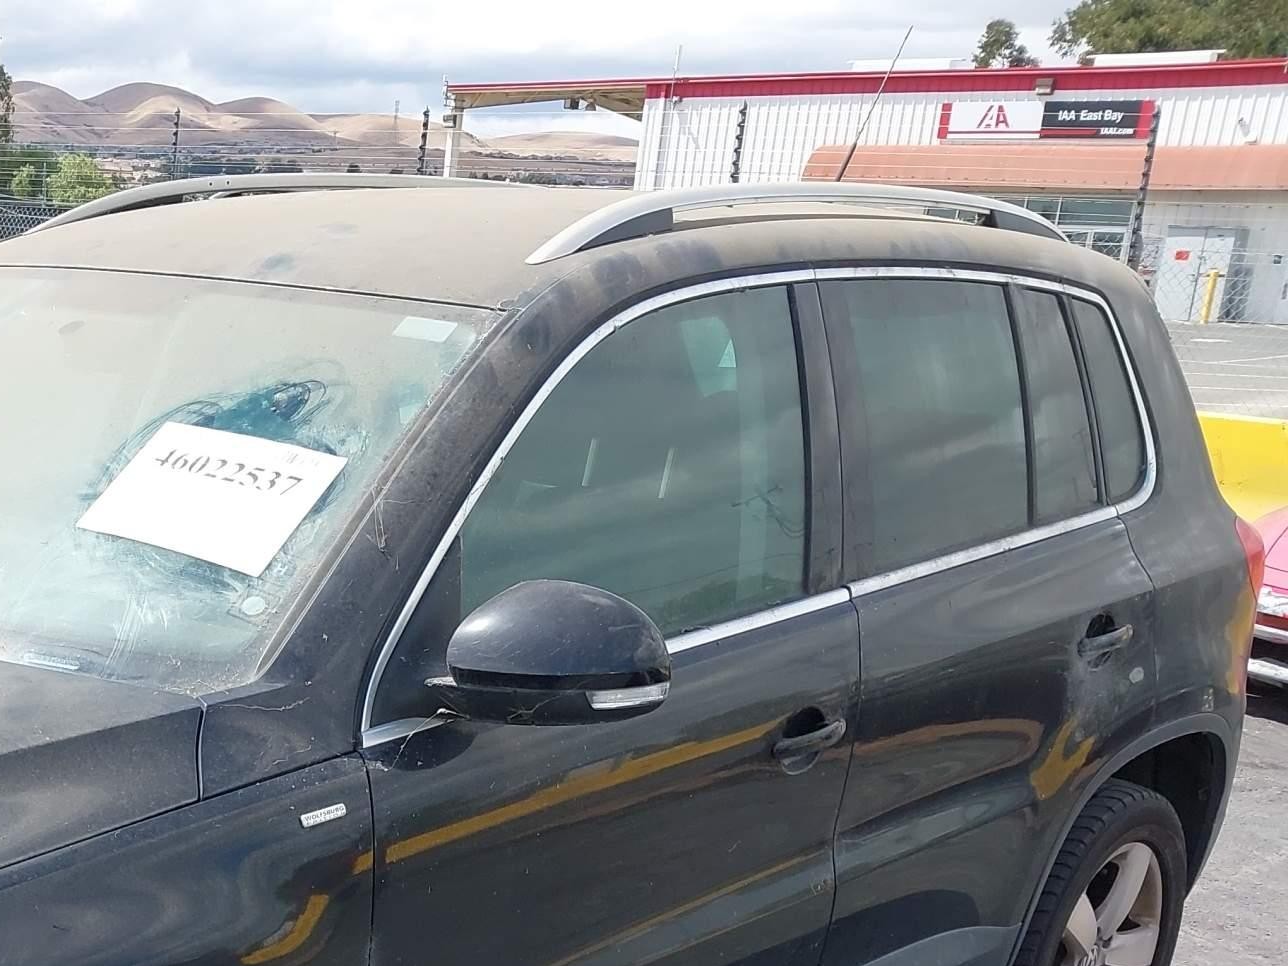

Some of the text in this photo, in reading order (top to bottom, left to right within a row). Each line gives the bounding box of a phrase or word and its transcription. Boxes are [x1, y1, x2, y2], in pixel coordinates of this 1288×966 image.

[1057, 109, 1125, 124] IAA East Bay
[155, 449, 304, 496] 46022537
